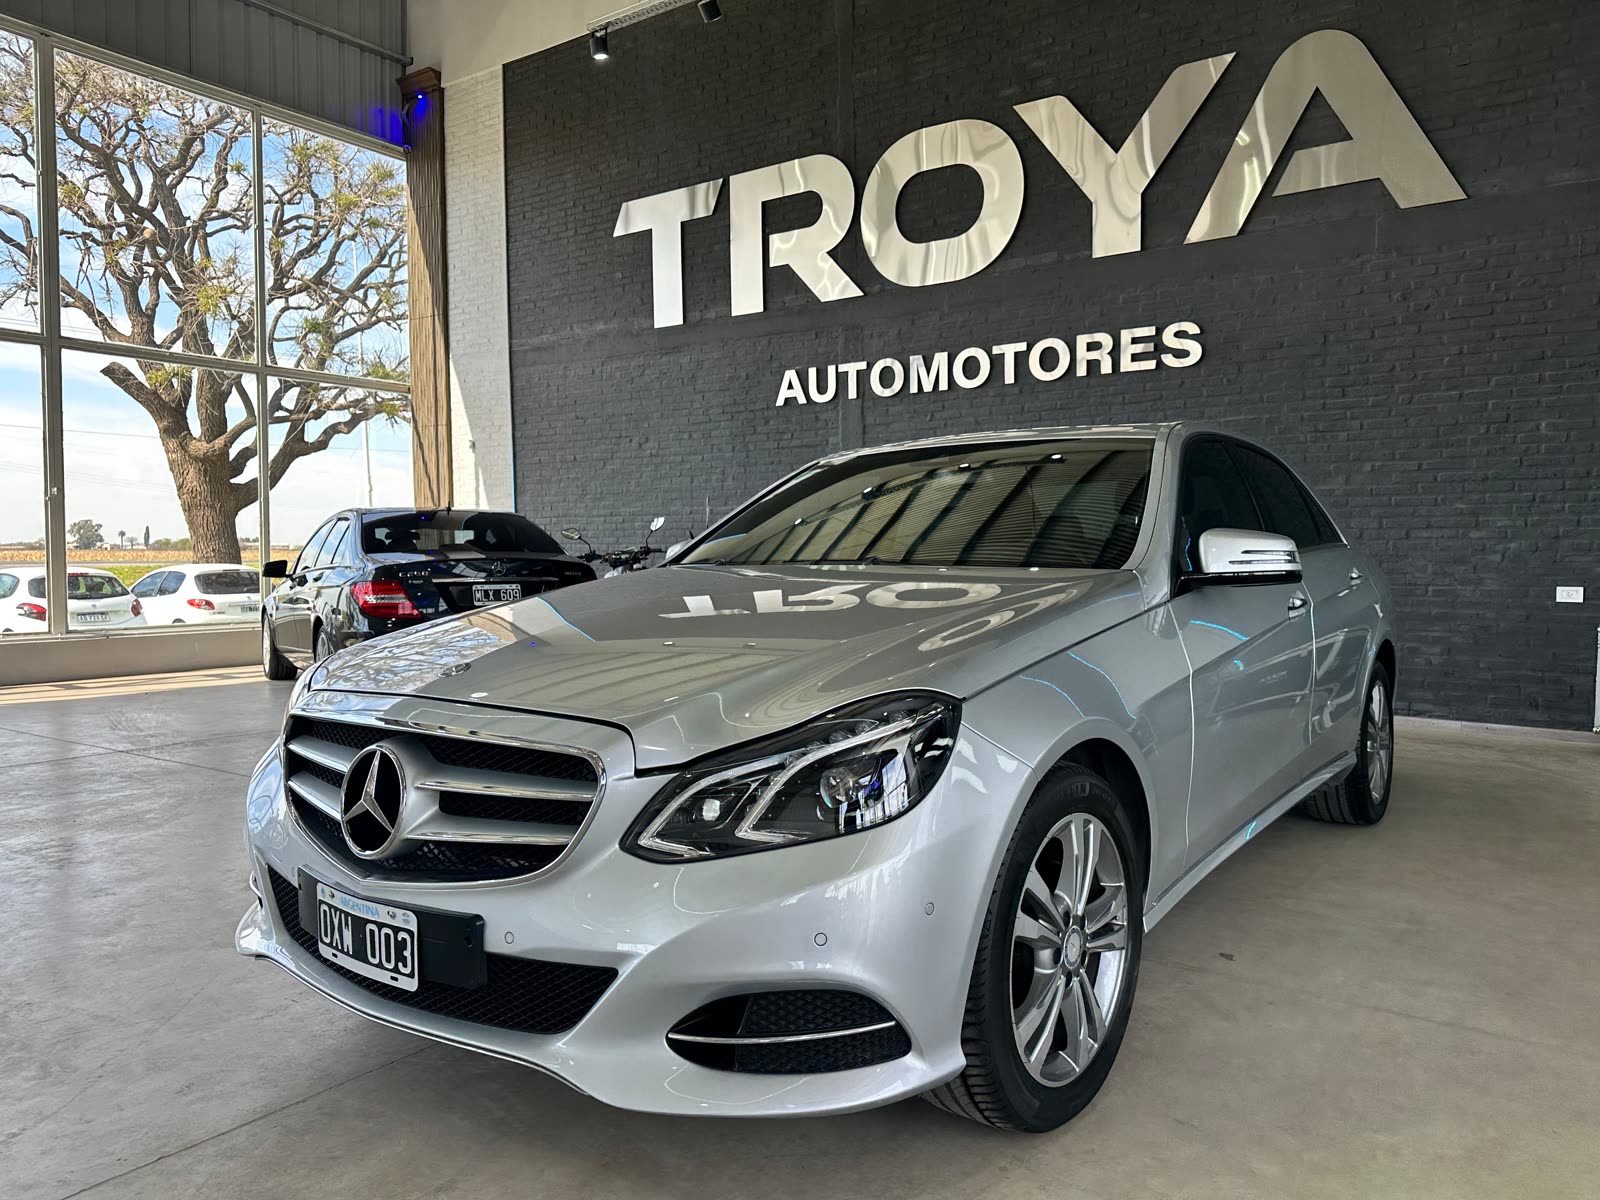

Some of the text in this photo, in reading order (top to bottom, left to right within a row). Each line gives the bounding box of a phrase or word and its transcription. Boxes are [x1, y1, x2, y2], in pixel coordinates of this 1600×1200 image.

[613, 29, 1468, 329] TROYA
[775, 320, 1203, 407] AUTOMOTORES
[474, 589, 520, 602] MLX 609
[320, 904, 412, 975] OXW 003
[340, 896, 380, 918] ARGENTINA
